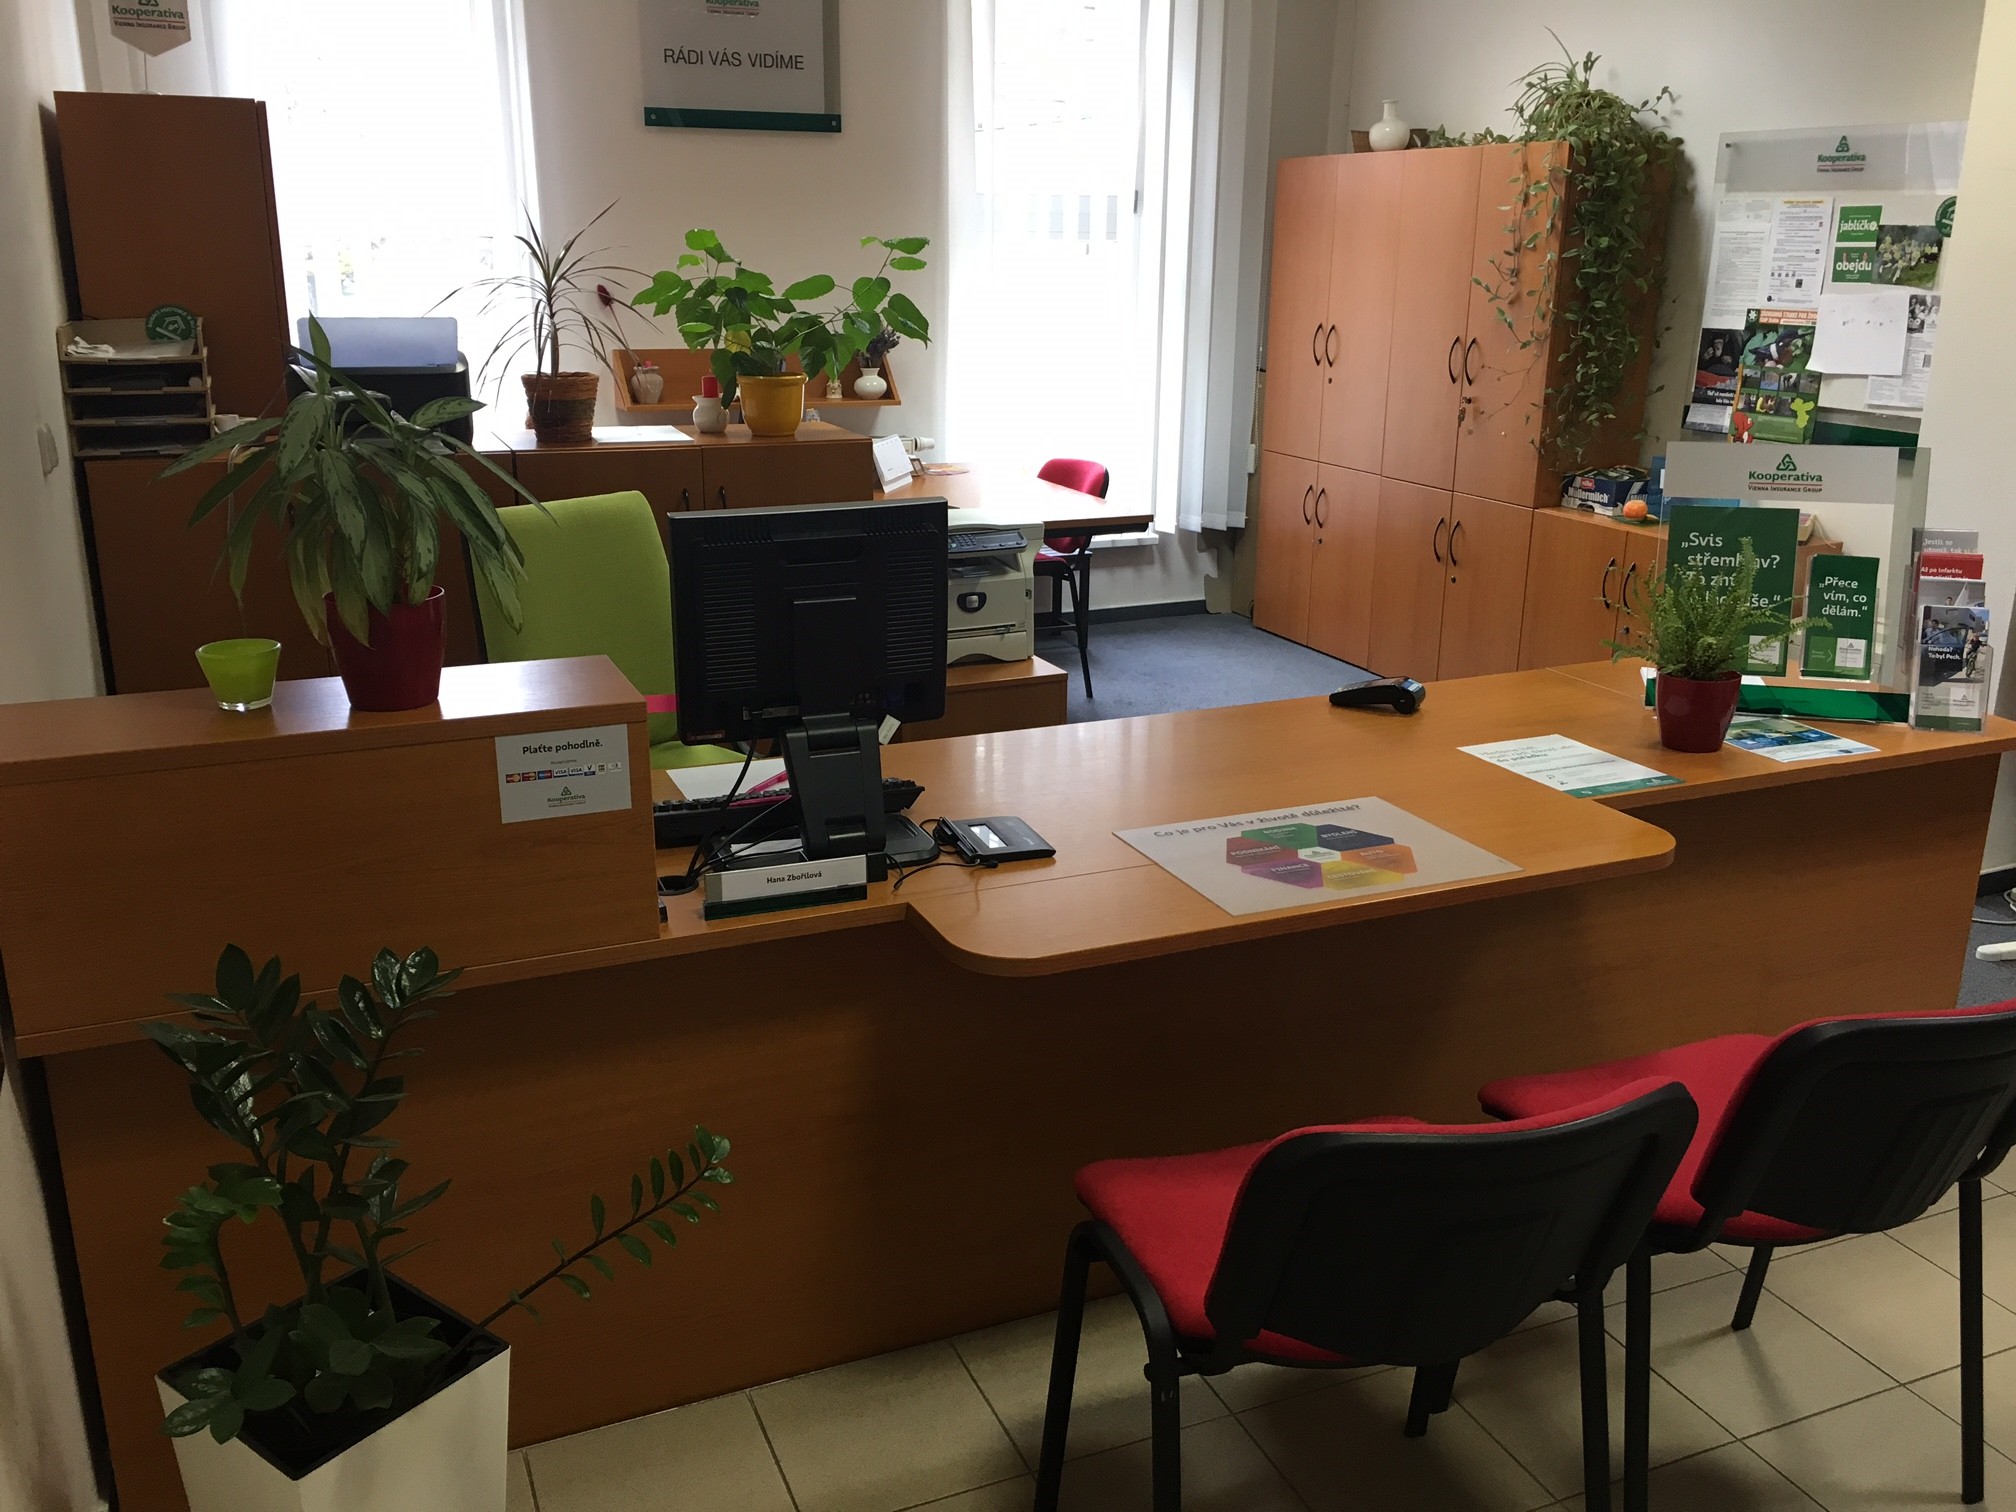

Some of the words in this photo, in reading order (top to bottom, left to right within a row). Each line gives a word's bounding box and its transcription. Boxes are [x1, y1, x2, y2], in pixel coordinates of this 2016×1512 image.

[111, 5, 184, 20] Kooperativa
[663, 45, 704, 65] RÁDI
[708, 47, 742, 67] VÁS
[747, 50, 805, 70] VIDÍME
[1817, 153, 1866, 164] Kooperativa
[1836, 254, 1872, 273] obejdu
[1748, 470, 1823, 482] Kooperativa
[1681, 532, 1723, 548] „Svis
[1819, 576, 1858, 588] „Přece
[1823, 590, 1849, 603] vím,
[1853, 594, 1867, 603] co
[1821, 604, 1868, 617] dělám.“
[522, 743, 553, 755] Plaťte
[555, 738, 603, 754] pohodlně.
[547, 794, 586, 803] Kooperativa
[1176, 828, 1190, 837] je
[1193, 824, 1217, 834] pro
[1217, 820, 1244, 829] Vás
[1256, 812, 1300, 824] životě
[1301, 804, 1361, 818] důležité?
[1271, 863, 1311, 872] FINANCE
[787, 870, 822, 882] Zbořilová
